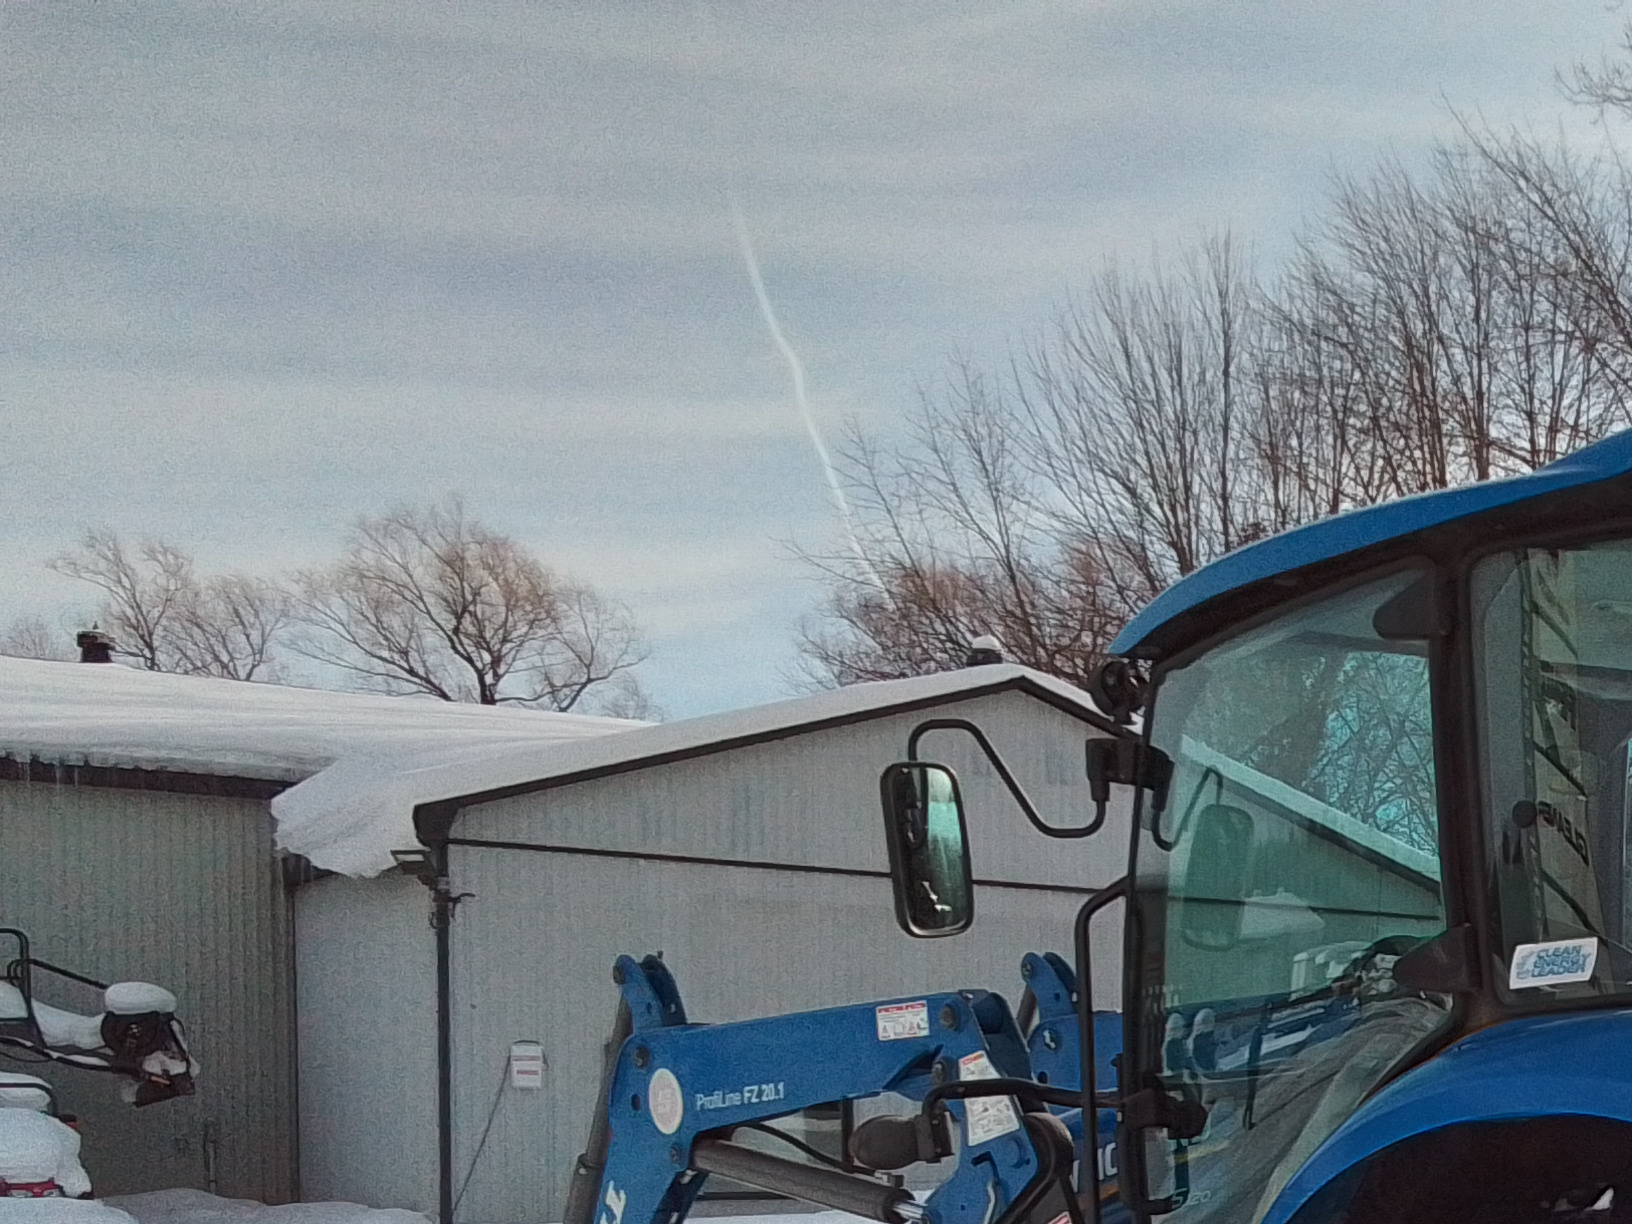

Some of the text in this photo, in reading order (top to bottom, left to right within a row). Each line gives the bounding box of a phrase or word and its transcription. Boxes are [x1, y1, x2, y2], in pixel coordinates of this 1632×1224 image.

[1536, 944, 1583, 960] CLEAN
[1533, 953, 1591, 968] ENERGY
[1531, 964, 1586, 978] LEADER
[743, 1085, 759, 1104] FZ
[761, 1081, 785, 1102] 20.1
